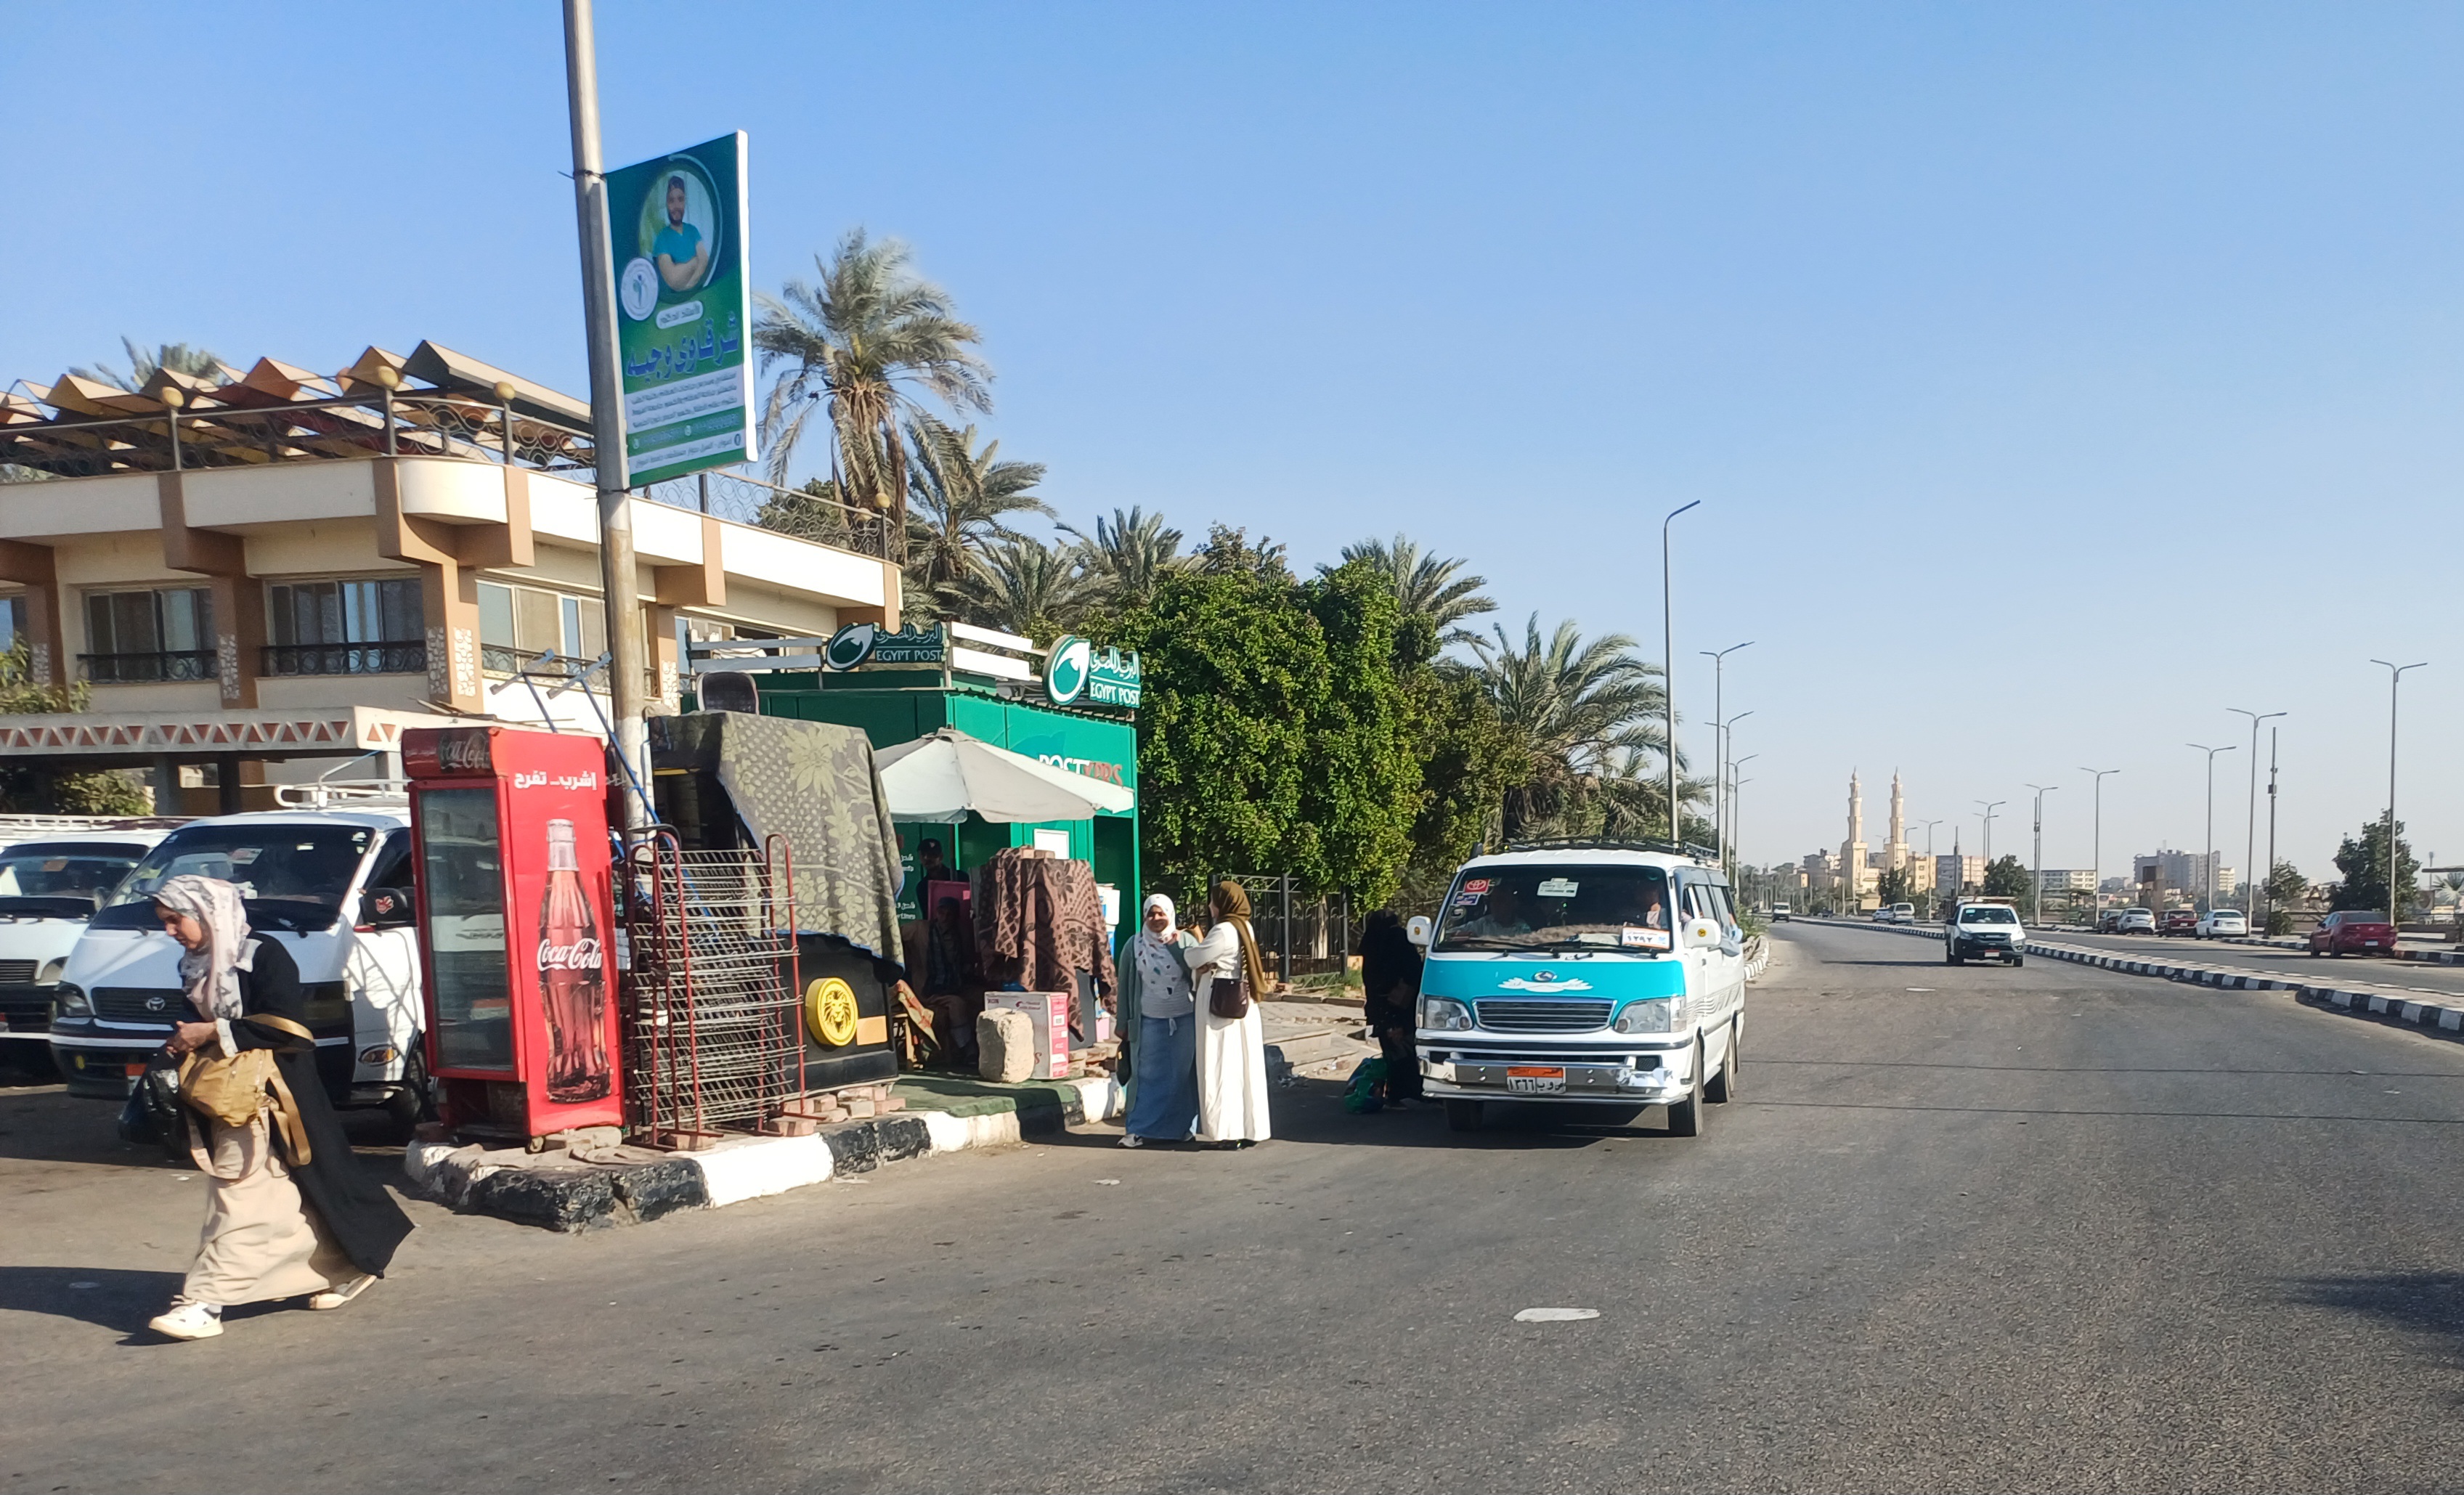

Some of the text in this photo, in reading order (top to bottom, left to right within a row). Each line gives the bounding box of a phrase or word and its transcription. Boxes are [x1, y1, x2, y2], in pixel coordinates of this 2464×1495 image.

[908, 624, 942, 644] البريد
[876, 649, 942, 661] EGYPT POST
[1113, 652, 1139, 680] البريد
[1090, 682, 1139, 706] EGYPT POST
[514, 770, 547, 789] تفرح
[537, 937, 602, 971] Coca-Cola
